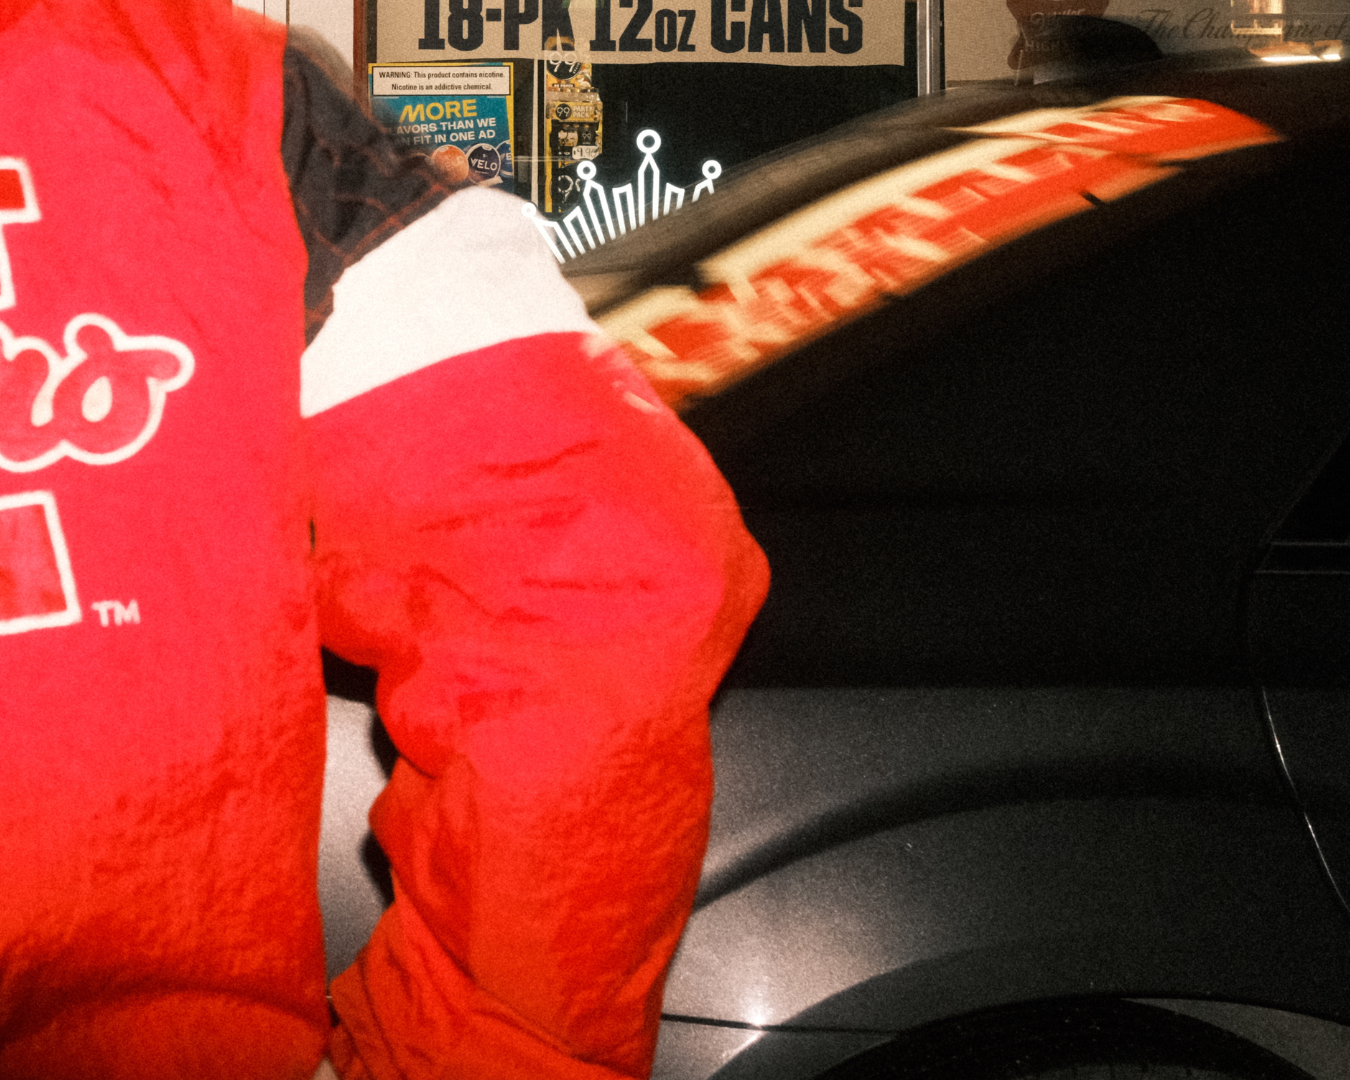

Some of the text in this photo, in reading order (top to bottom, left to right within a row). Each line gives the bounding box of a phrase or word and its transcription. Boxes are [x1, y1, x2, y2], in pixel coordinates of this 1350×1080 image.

[549, 52, 577, 72] 99
[379, 71, 412, 79] WARNING:
[414, 71, 426, 79] This
[428, 71, 451, 80] product
[452, 71, 478, 79] contains
[398, 99, 478, 123] MORE
[557, 106, 570, 117] 99
[440, 119, 475, 131] THAN
[477, 117, 497, 127] WE
[413, 135, 432, 145] FIT
[434, 133, 447, 143] IN
[450, 131, 476, 142] ONE
[479, 129, 496, 139] AD
[470, 157, 498, 171] VELO
[91, 599, 141, 628] TM
